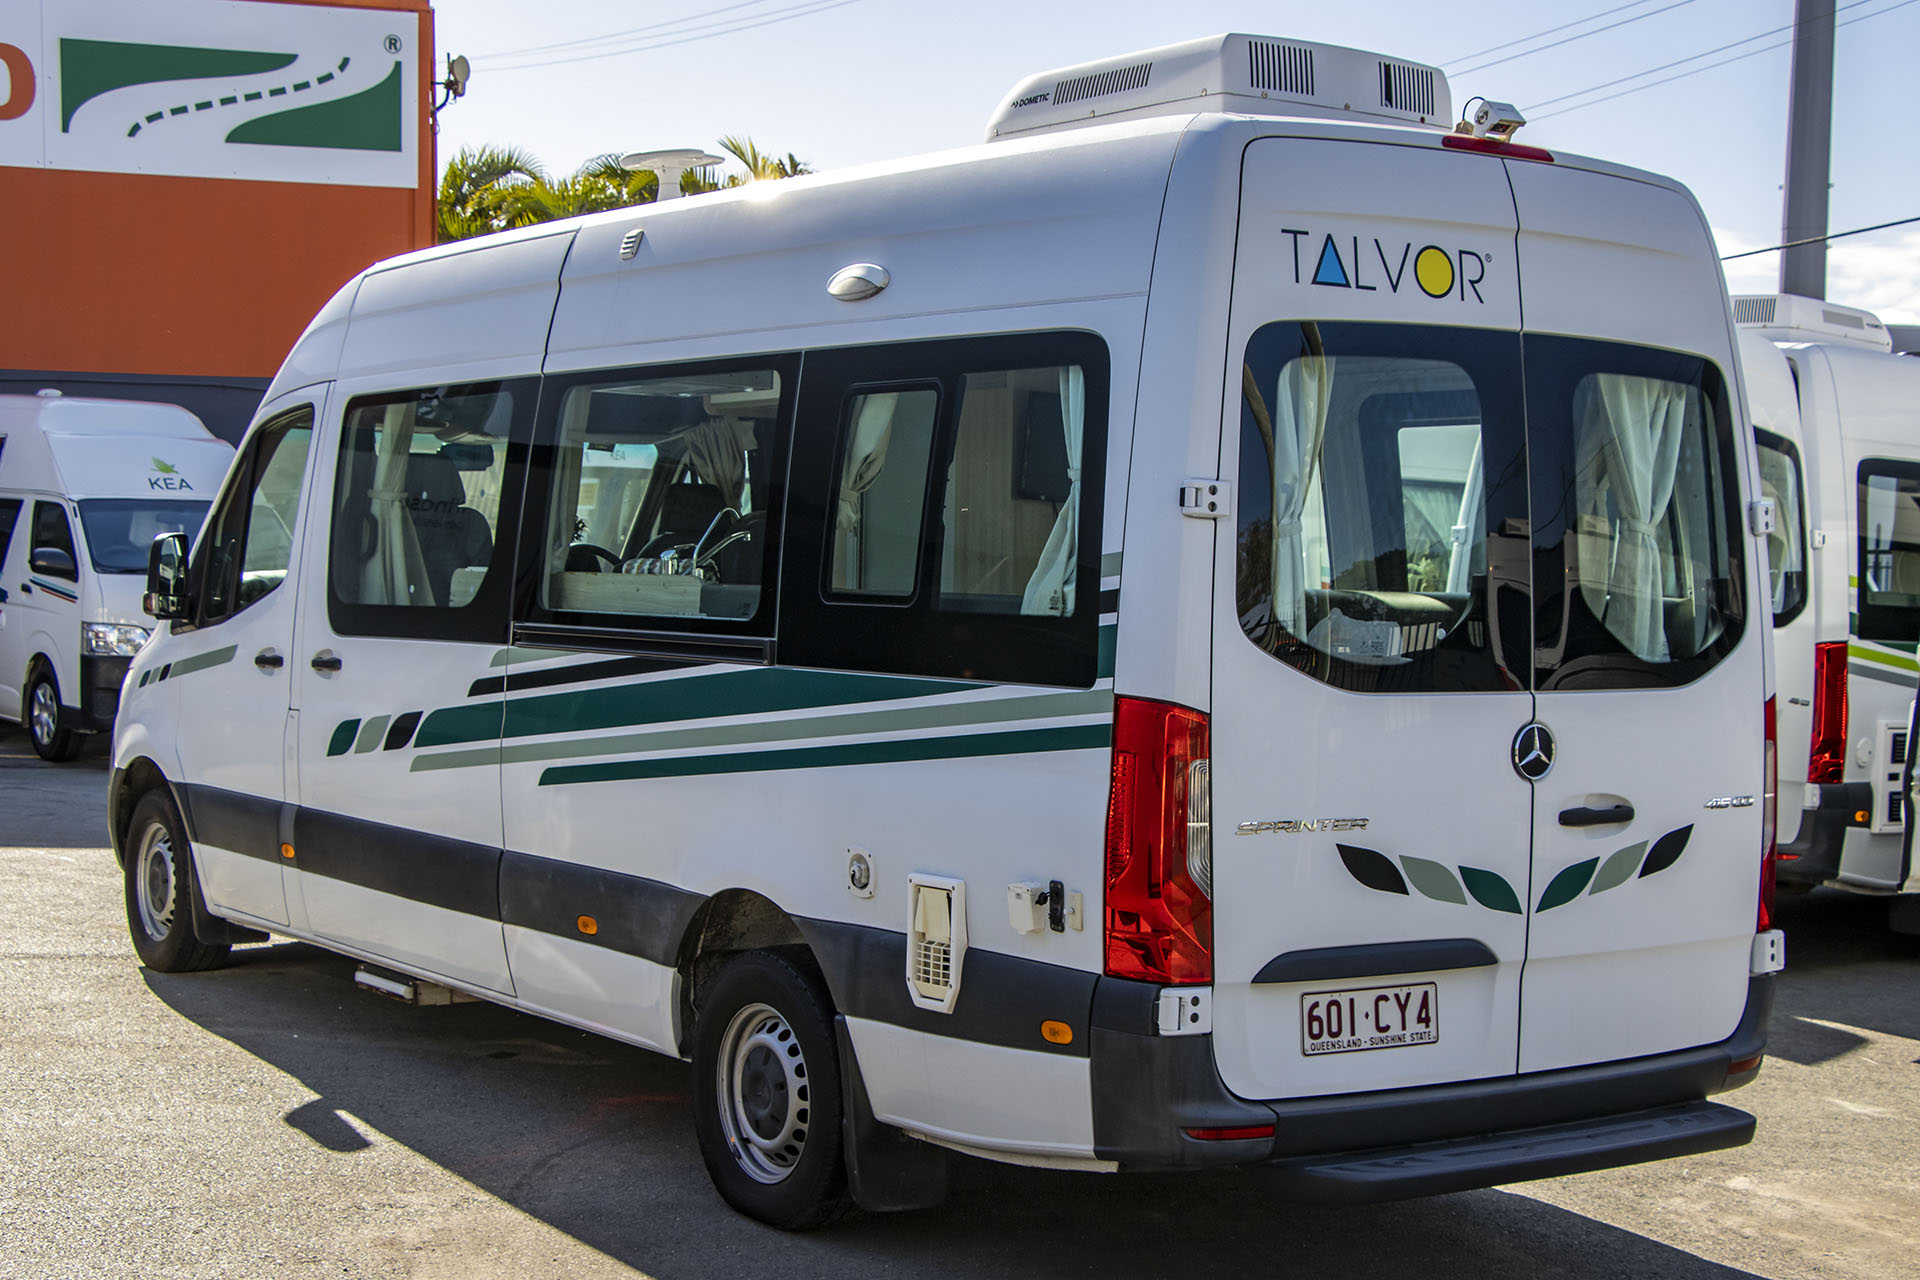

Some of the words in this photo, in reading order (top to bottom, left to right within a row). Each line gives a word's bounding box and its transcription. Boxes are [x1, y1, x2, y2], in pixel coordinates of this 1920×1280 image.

[1018, 92, 1050, 108] DOMETIC
[148, 477, 194, 491] KEA
[1235, 818, 1370, 836] SPRINTER
[1310, 1038, 1362, 1052] QUEENSLAND
[1369, 1033, 1407, 1046] SUNSHINE
[1410, 1030, 1432, 1041] STATE
